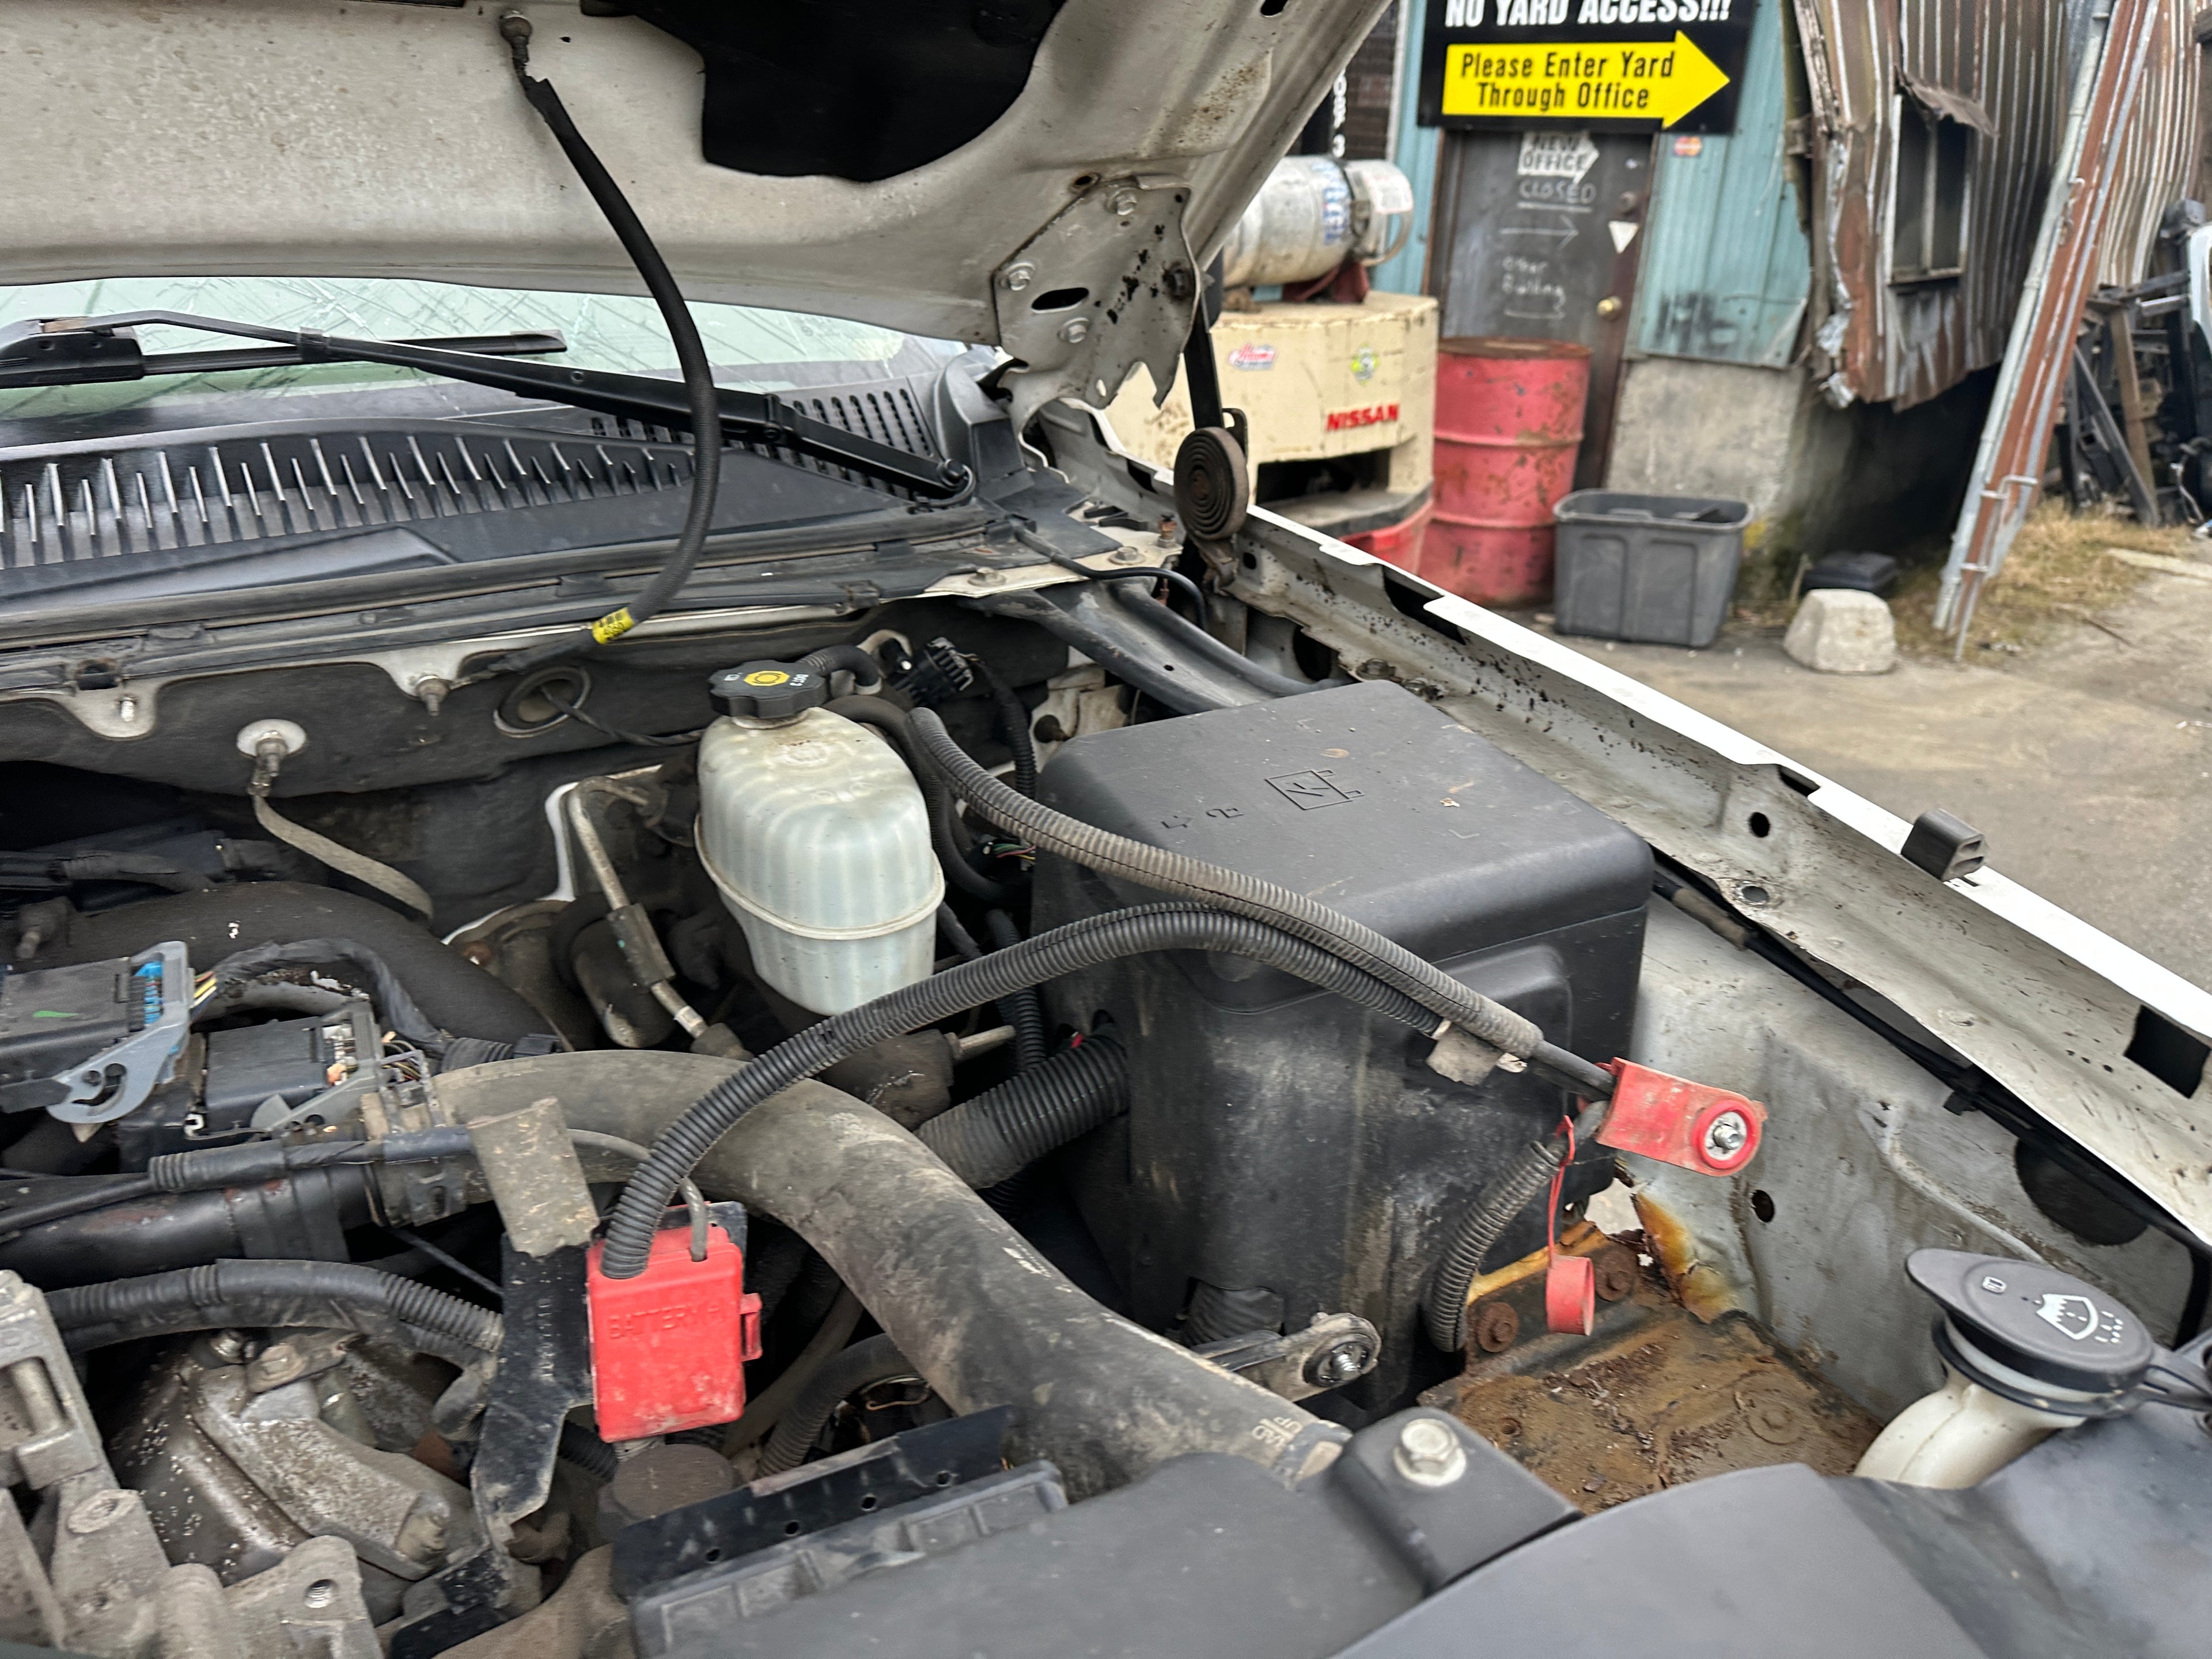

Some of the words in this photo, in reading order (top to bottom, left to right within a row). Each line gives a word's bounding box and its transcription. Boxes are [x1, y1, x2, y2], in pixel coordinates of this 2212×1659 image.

[1445, 0, 1485, 27] NO
[1497, 0, 1569, 26] YARD
[1577, 0, 1730, 24] ACCESS!!!
[1461, 52, 1533, 78] Please
[1544, 51, 1607, 78] Enter
[1621, 50, 1675, 78] Yard
[1478, 82, 1565, 112] Through
[1577, 82, 1649, 108] Office
[1523, 152, 1588, 171] OFFICE
[1518, 180, 1597, 204] CLOSED
[1326, 403, 1400, 432] NISSAN
[791, 674, 809, 683] DOT
